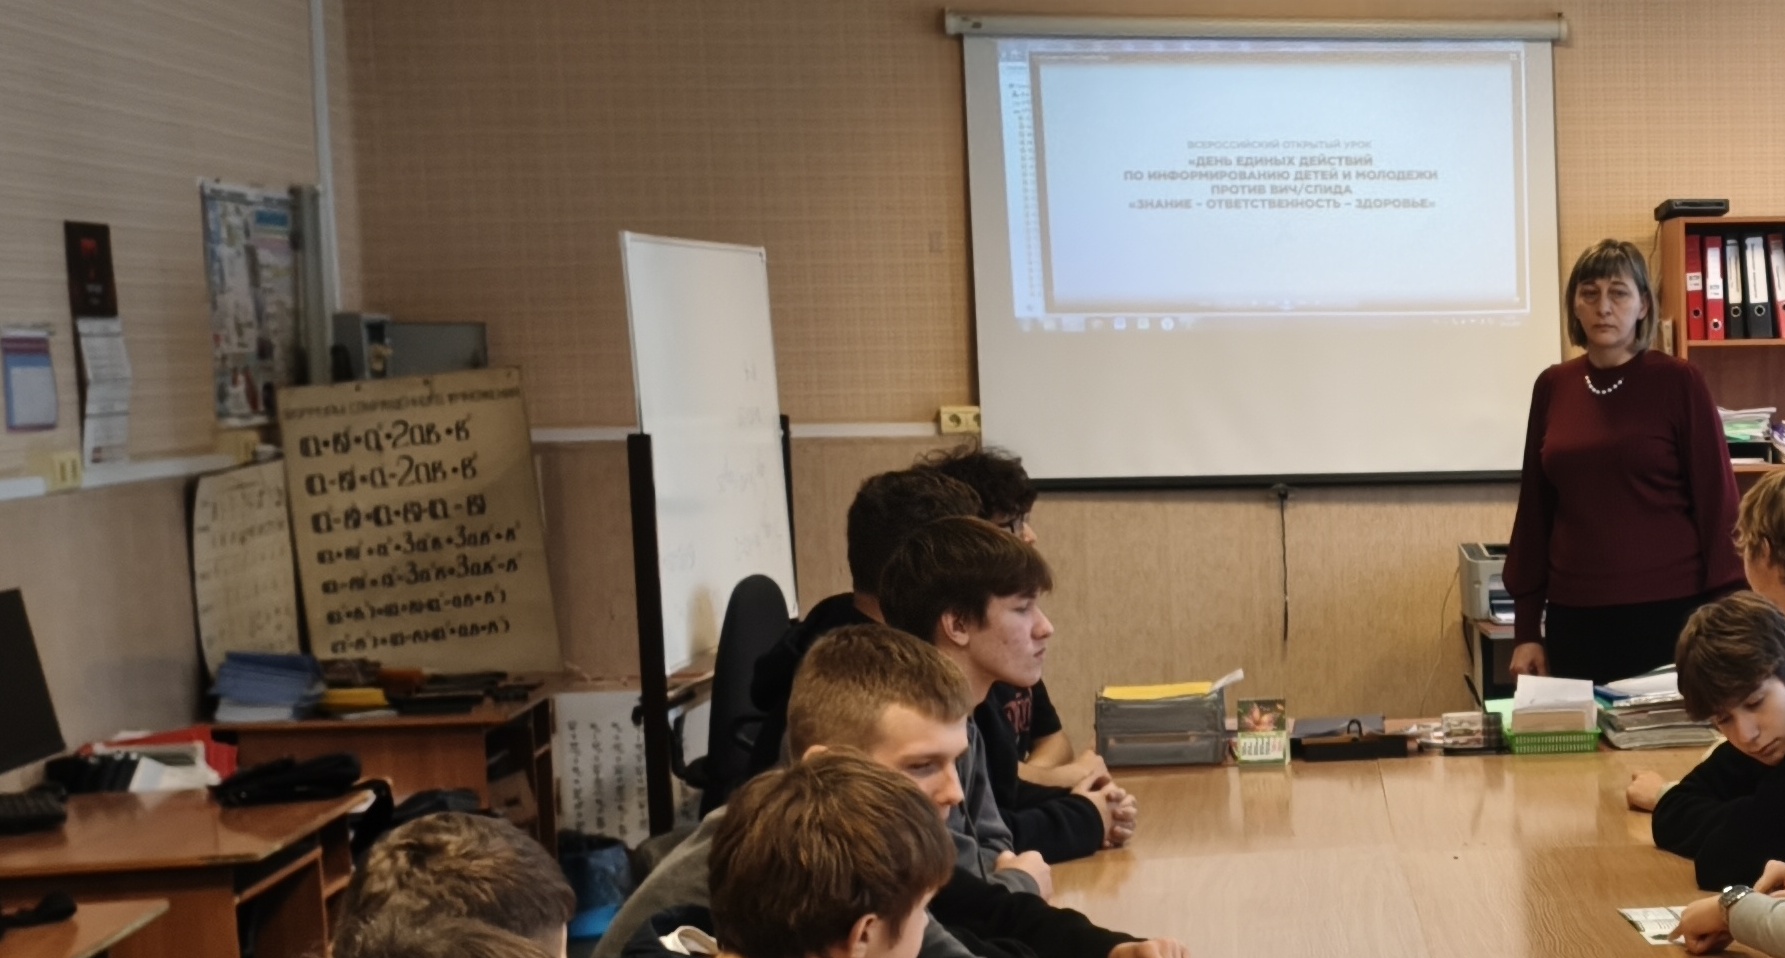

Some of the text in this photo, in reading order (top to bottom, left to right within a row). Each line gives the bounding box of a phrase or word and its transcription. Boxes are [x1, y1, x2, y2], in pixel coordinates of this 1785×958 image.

[1187, 139, 1372, 149] ВСЕРОССИЙСКИЙ ОТКРЫТЫЙ УРОК
[1188, 154, 1373, 167] «ДЕНЬ ЕДИНЫХ ДЕЙСТВИЙ
[1124, 168, 1438, 181] ПО ИНФОРМИРОВАНИЮ ДЕТЕЙ И МОЛОДЕЖИ
[1211, 184, 1352, 196] ПРОТИВ ВИЧ/СПИДА
[1206, 199, 1341, 209] ОТВЕТСТВЕННОСТЬ
